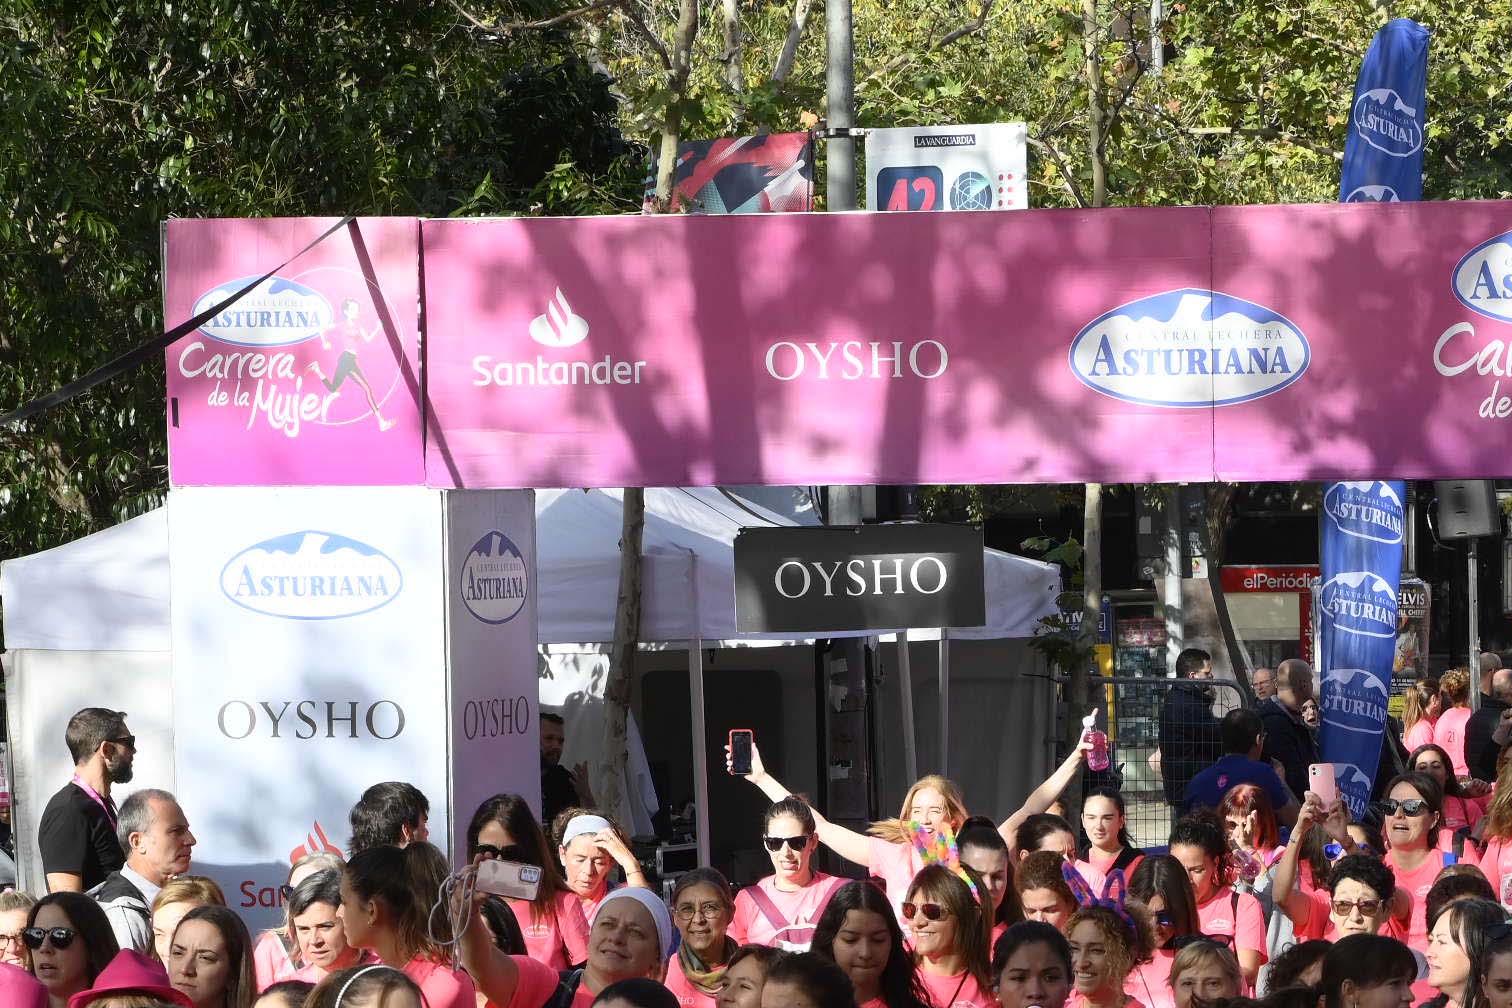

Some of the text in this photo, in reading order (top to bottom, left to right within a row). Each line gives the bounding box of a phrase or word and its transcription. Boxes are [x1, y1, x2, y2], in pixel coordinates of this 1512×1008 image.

[178, 341, 295, 379] Carrera
[472, 354, 646, 387] Santander
[765, 339, 949, 381] OYSHO
[1088, 333, 1292, 377] ASTURIANA
[207, 375, 341, 438] de la Mujer
[1478, 380, 1512, 419] de
[234, 564, 389, 598] ASTURIANA
[465, 565, 524, 601] ASTURIANA
[774, 556, 948, 599] OYSHO
[217, 699, 406, 740] OYSHO
[463, 695, 530, 741] OYSHO
